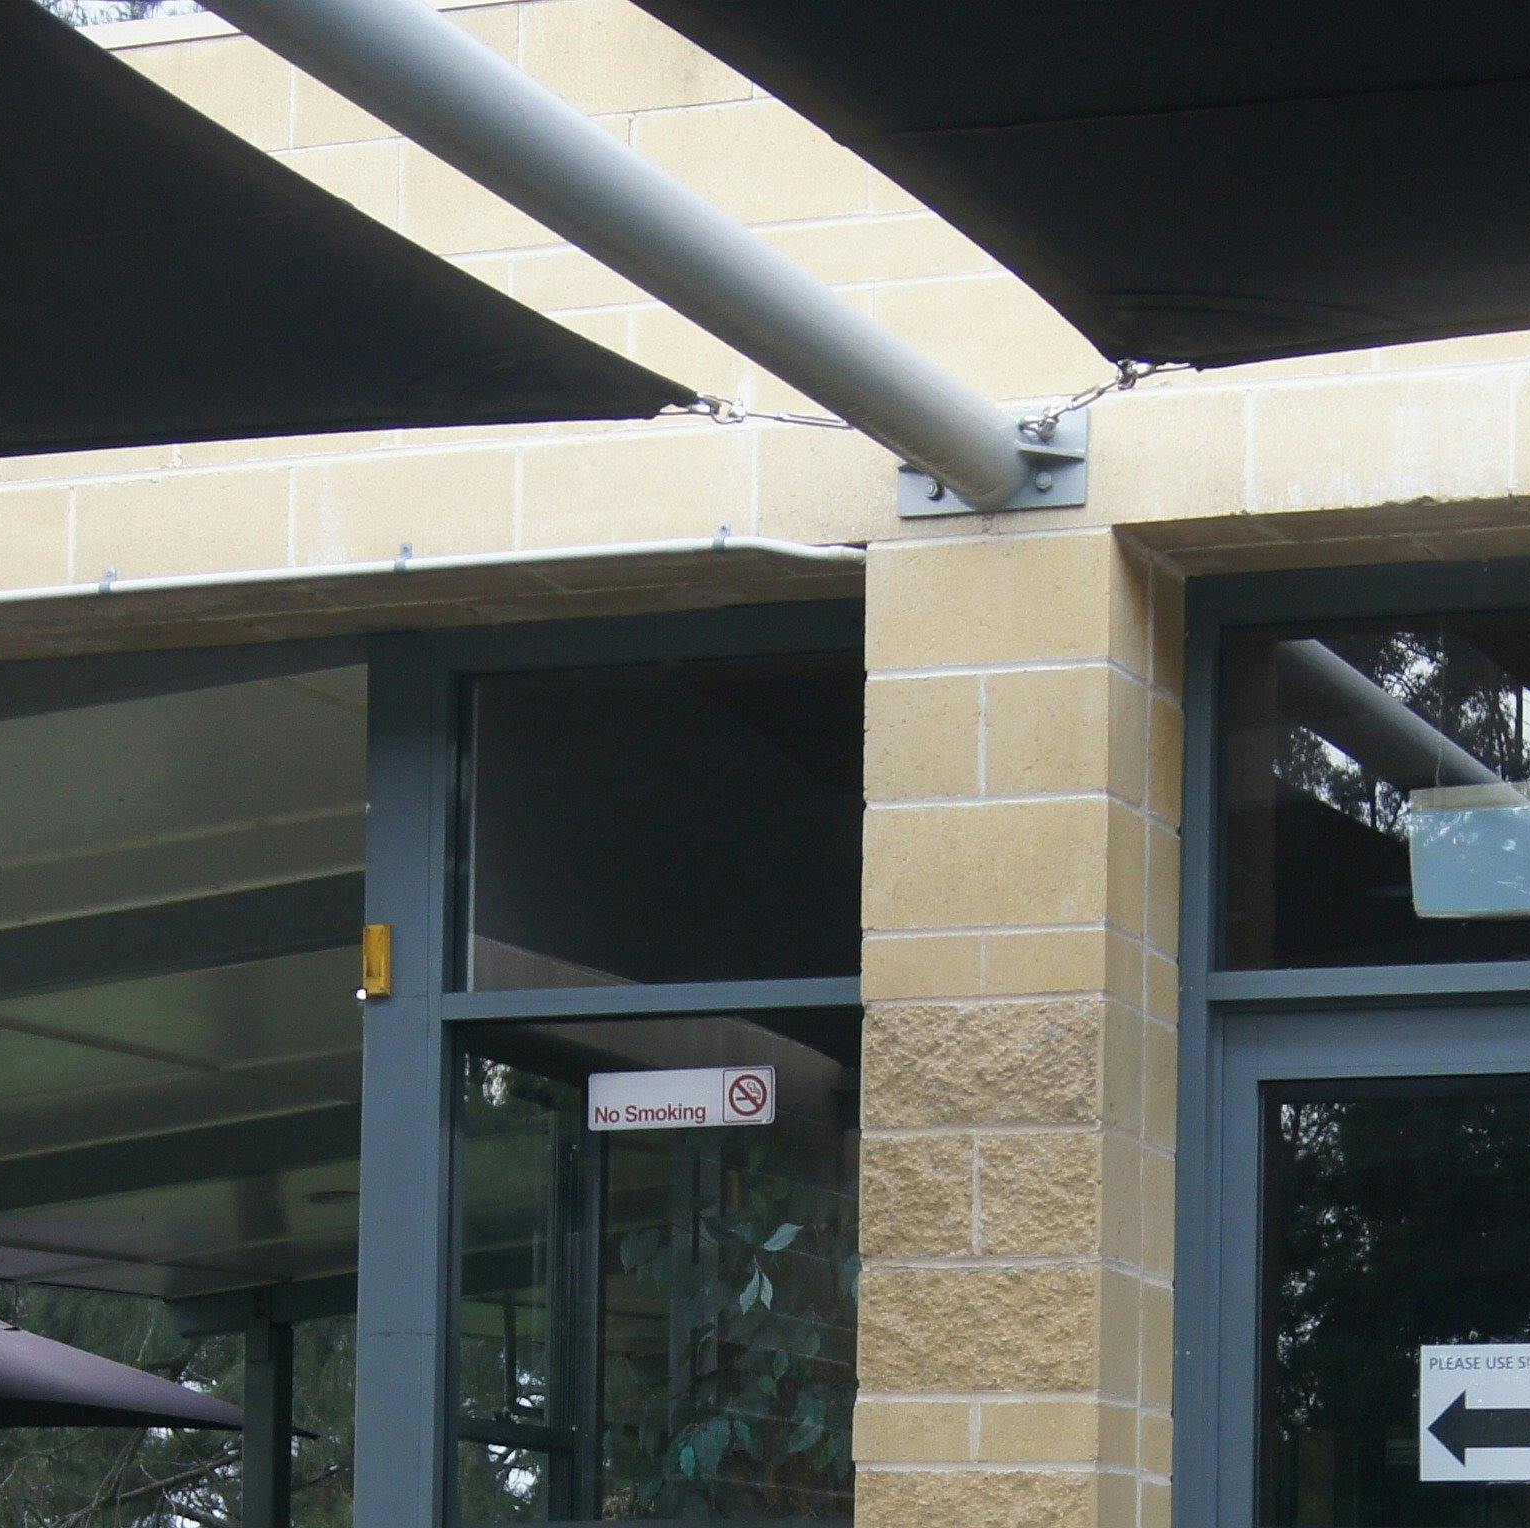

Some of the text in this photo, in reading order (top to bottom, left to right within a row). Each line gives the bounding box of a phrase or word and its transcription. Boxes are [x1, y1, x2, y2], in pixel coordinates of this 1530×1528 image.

[594, 1102, 706, 1124] No Smoking
[1429, 1357, 1481, 1371] PLEASE
[1486, 1356, 1514, 1370] USE
